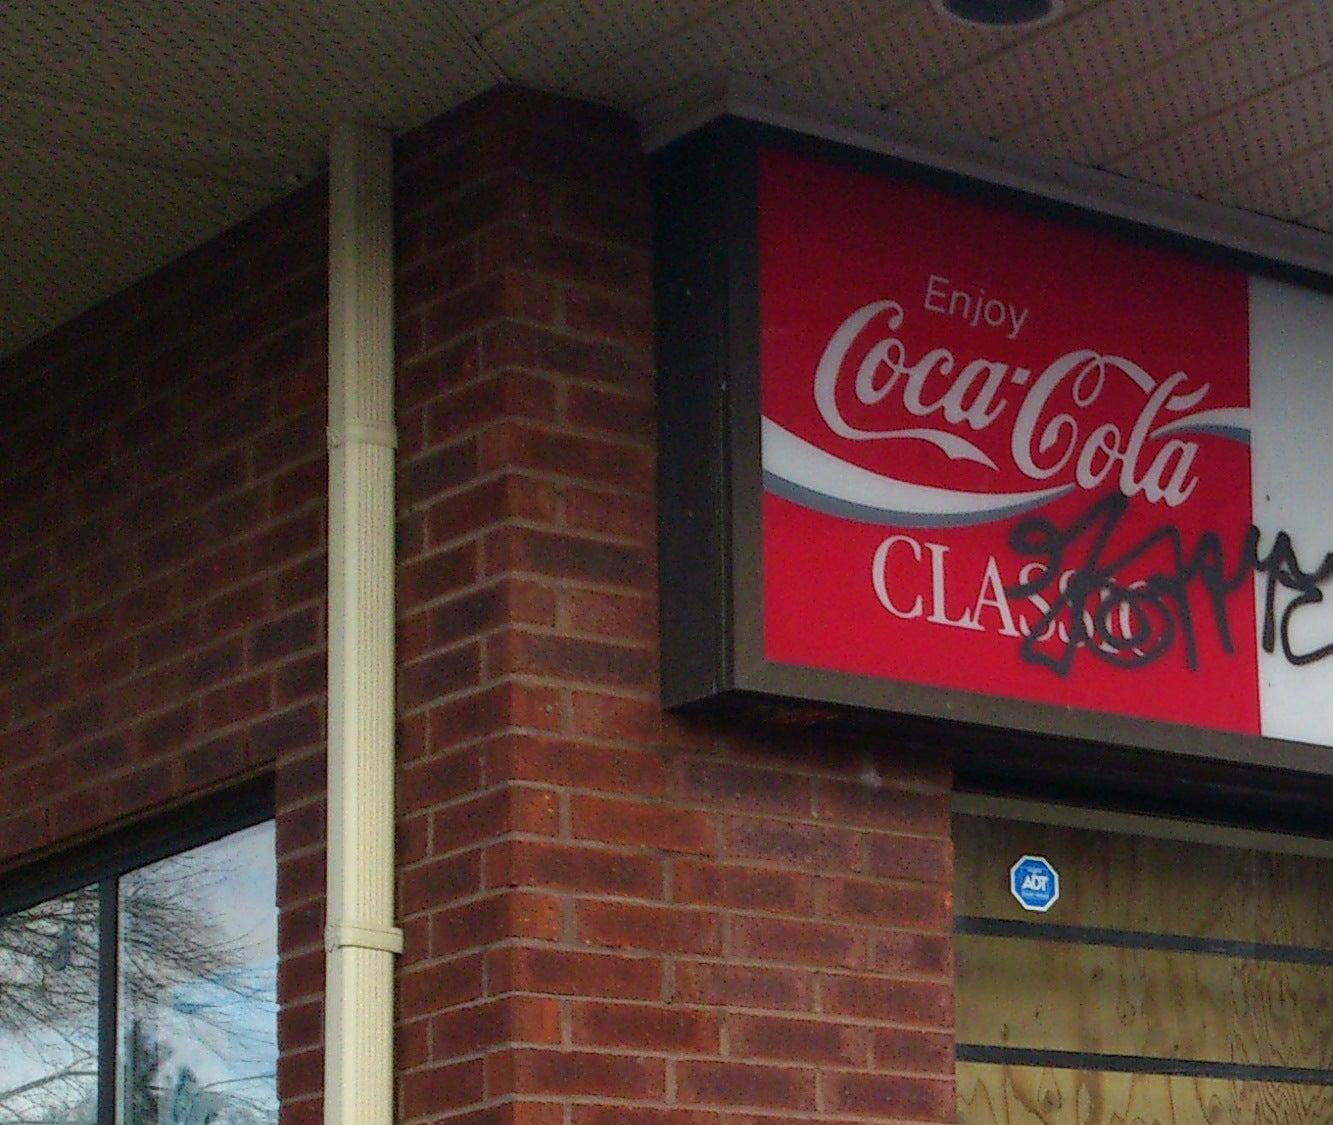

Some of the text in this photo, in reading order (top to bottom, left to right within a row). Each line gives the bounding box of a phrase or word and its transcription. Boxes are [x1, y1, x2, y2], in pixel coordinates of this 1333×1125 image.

[924, 274, 1029, 339] Enjoy
[813, 299, 1211, 508] Coca-Cola
[1021, 874, 1049, 891] ADT
